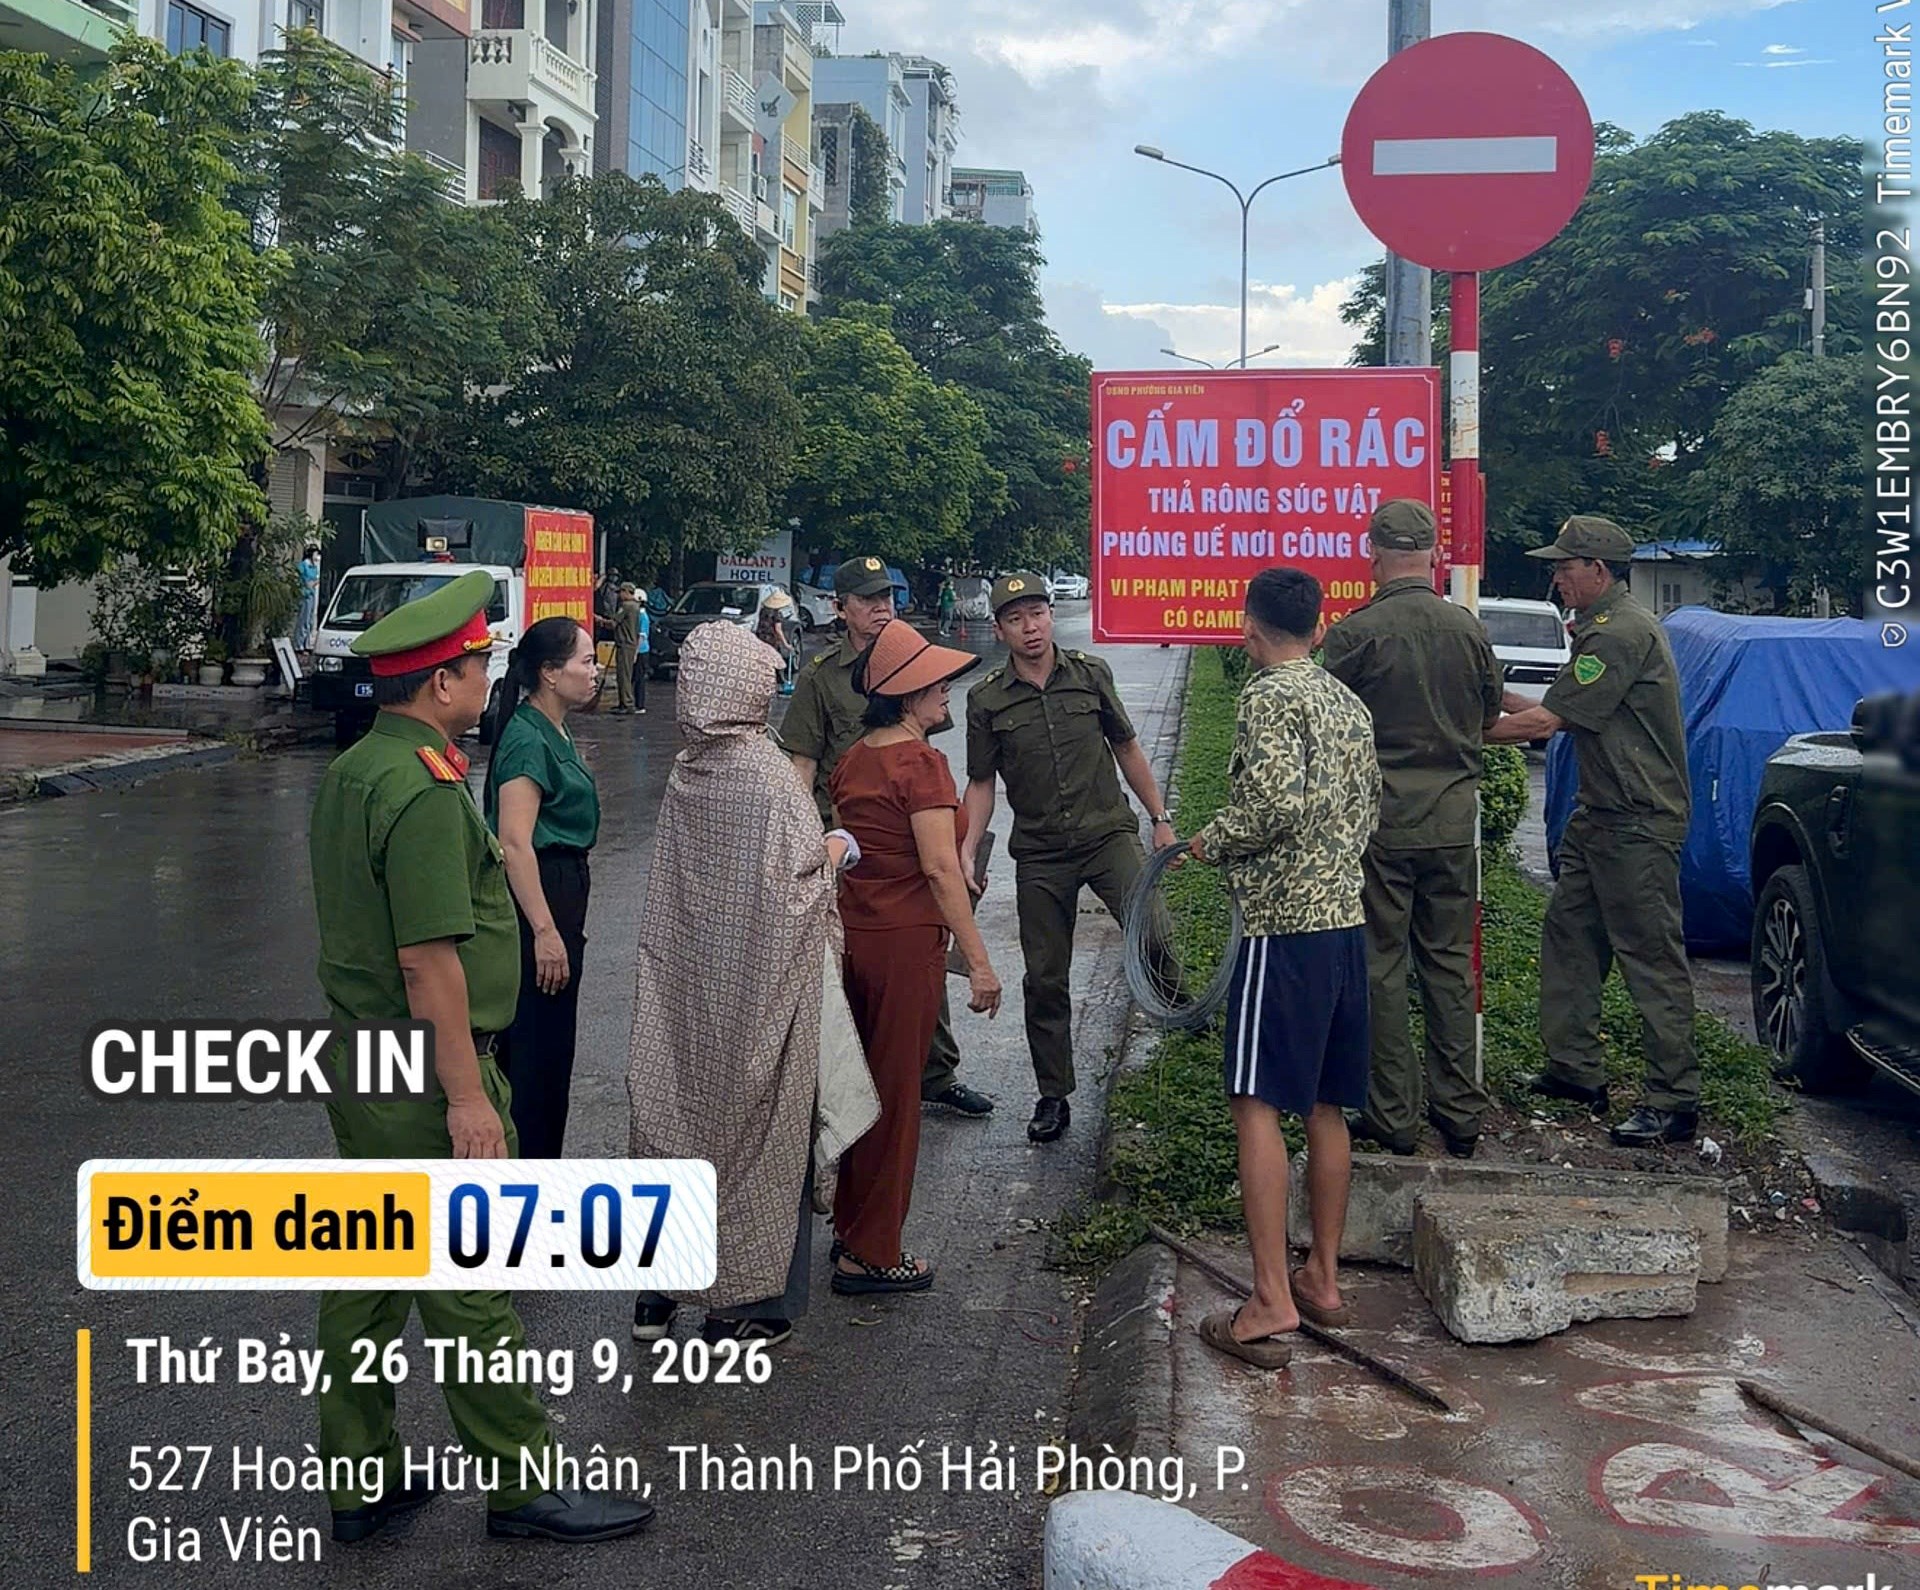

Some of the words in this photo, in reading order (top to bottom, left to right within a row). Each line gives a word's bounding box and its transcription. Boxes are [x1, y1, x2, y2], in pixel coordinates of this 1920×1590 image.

[1106, 402, 1219, 468] CẤM
[1234, 398, 1303, 467] ĐỔ
[1319, 407, 1425, 467] RÁC
[1148, 479, 1195, 513] THẢ
[1202, 482, 1270, 514] RÔNG
[1276, 482, 1327, 514] SÚC
[1334, 482, 1382, 519] VẬT
[1103, 525, 1187, 557] PHÓNG
[1193, 523, 1225, 557] UẾ
[1231, 529, 1275, 557] NƠI
[1282, 526, 1352, 558] CÔNG
[730, 569, 775, 582] HOTEL
[1110, 578, 1128, 596] VI
[1132, 578, 1187, 601] PHẠM
[1191, 578, 1239, 602] PHẠT
[1163, 605, 1188, 628] CÓ
[1193, 610, 1245, 629] CAME
